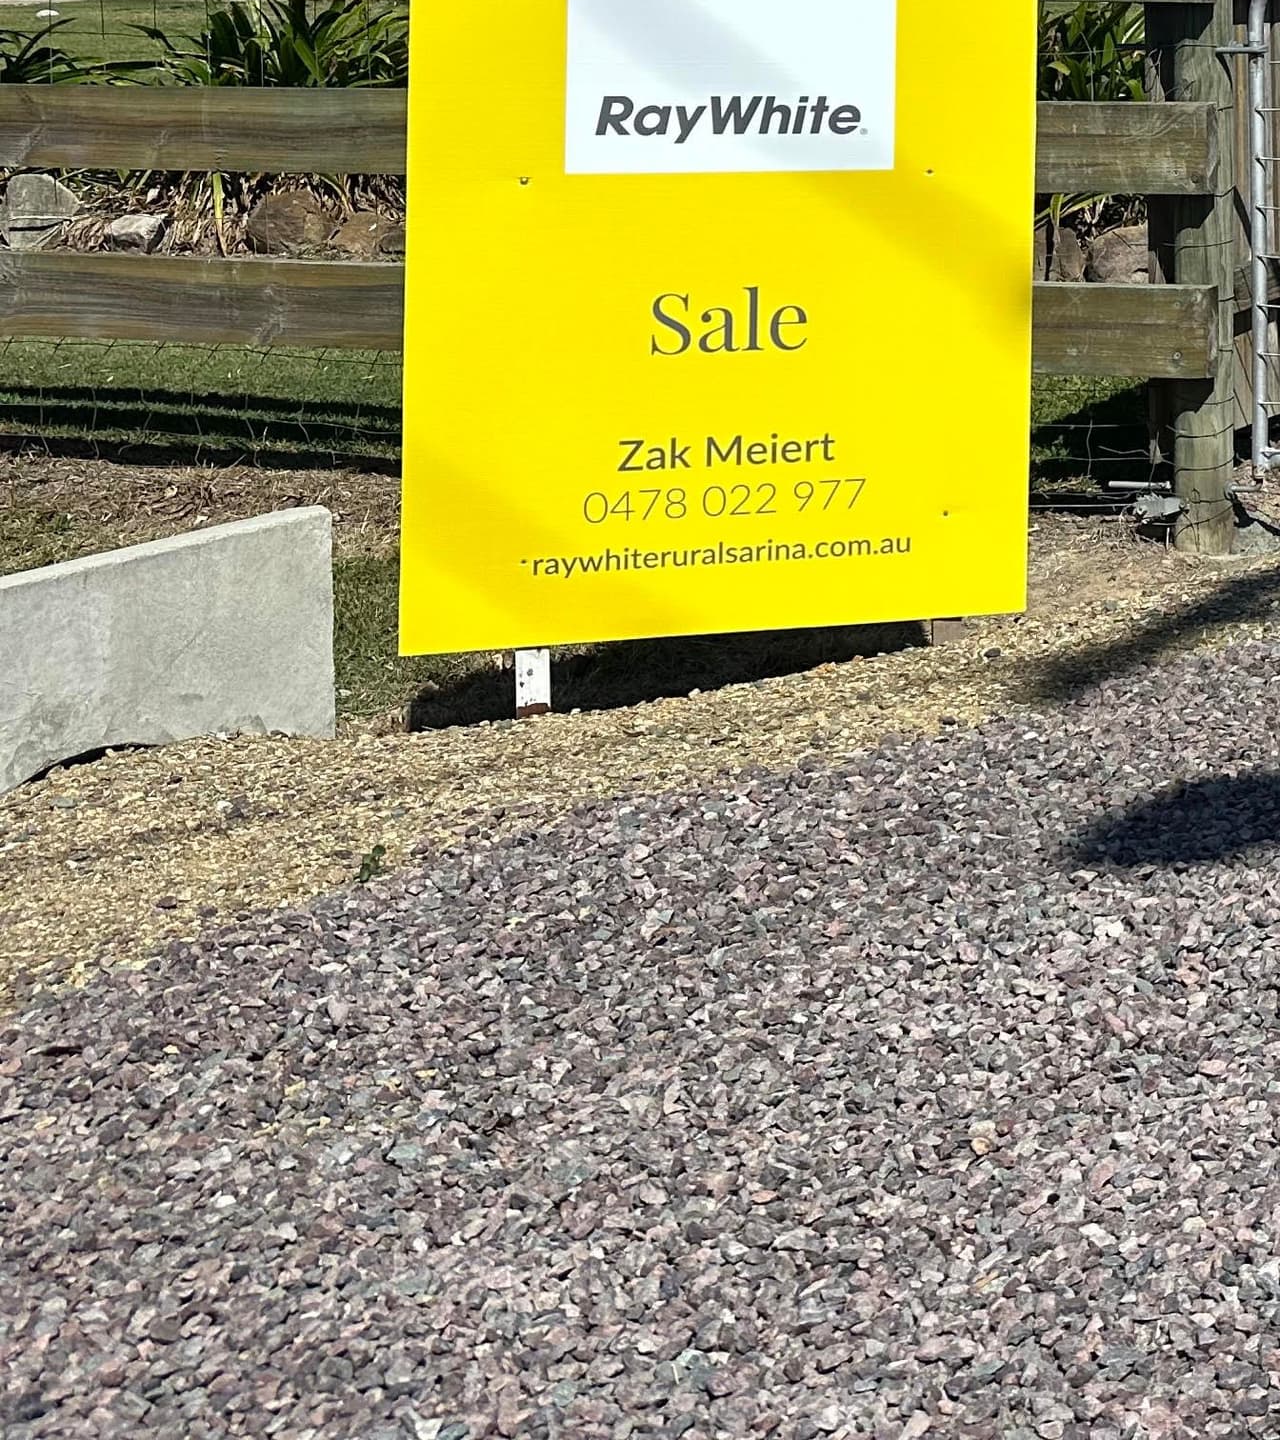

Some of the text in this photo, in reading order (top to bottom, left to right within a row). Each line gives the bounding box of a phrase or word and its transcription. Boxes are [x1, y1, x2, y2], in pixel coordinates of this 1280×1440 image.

[651, 286, 808, 356] Sale
[617, 433, 835, 472] Zak Meiert
[583, 478, 866, 524] 0478 022 977
[531, 537, 911, 579] raywhiteruralsarina.com.au
